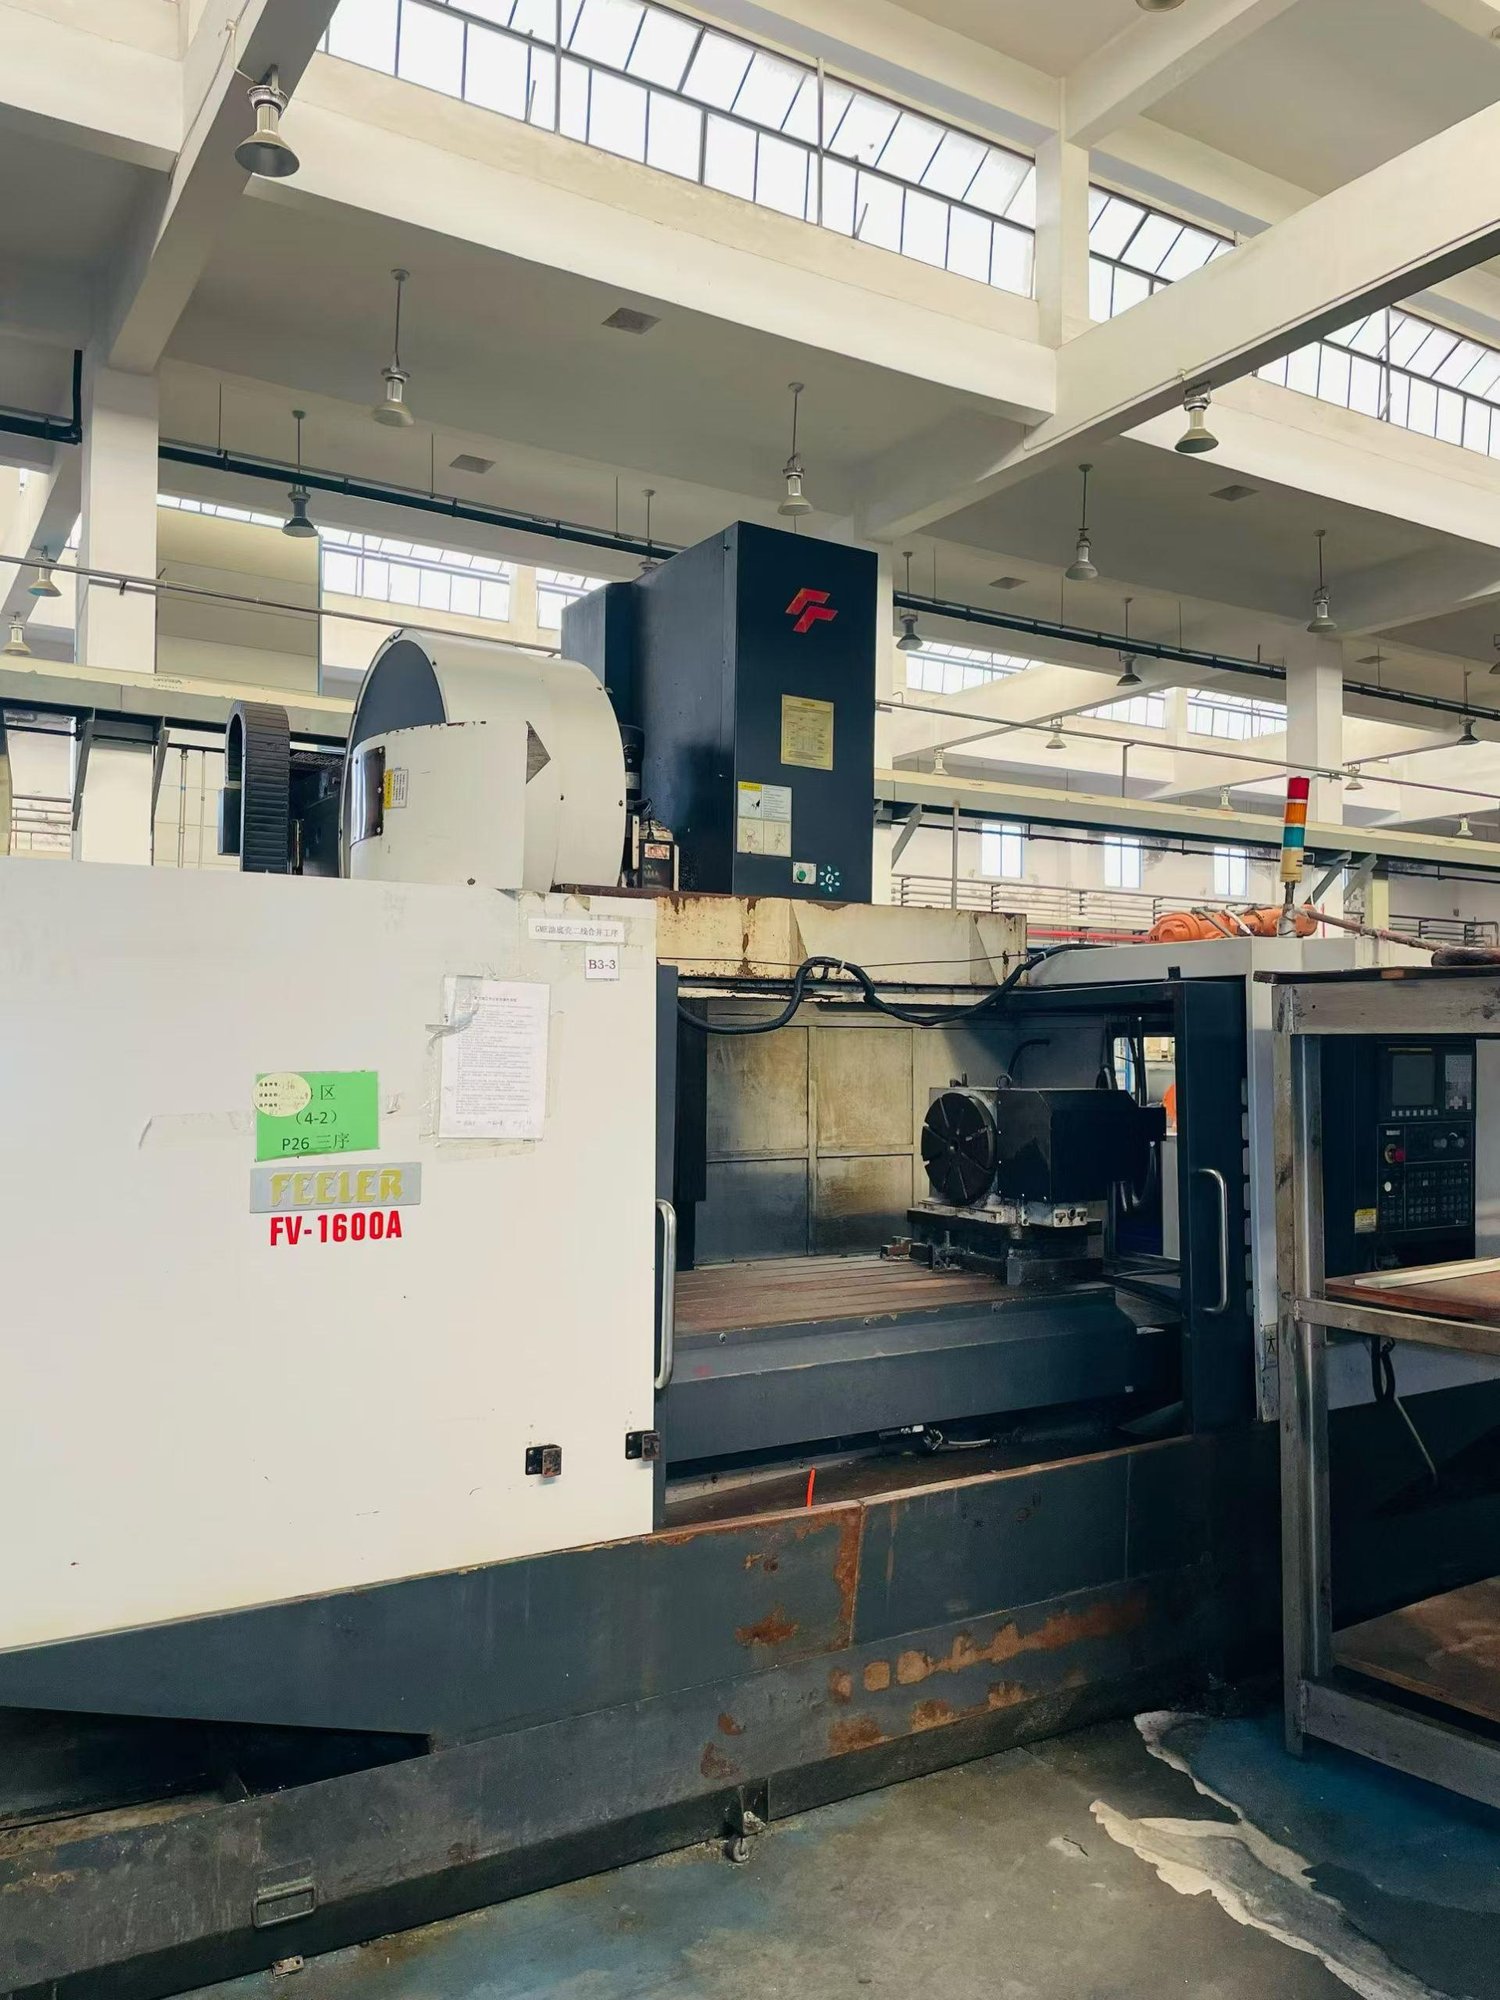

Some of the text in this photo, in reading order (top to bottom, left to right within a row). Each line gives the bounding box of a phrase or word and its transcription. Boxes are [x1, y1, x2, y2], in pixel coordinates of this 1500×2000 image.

[588, 959, 617, 970] B3-3
[320, 1084, 336, 1101] 区
[296, 1110, 338, 1126] (4-2)
[282, 1132, 350, 1151] P26 三序
[269, 1168, 404, 1207] FEELER
[270, 1210, 403, 1246] FV-1600A
